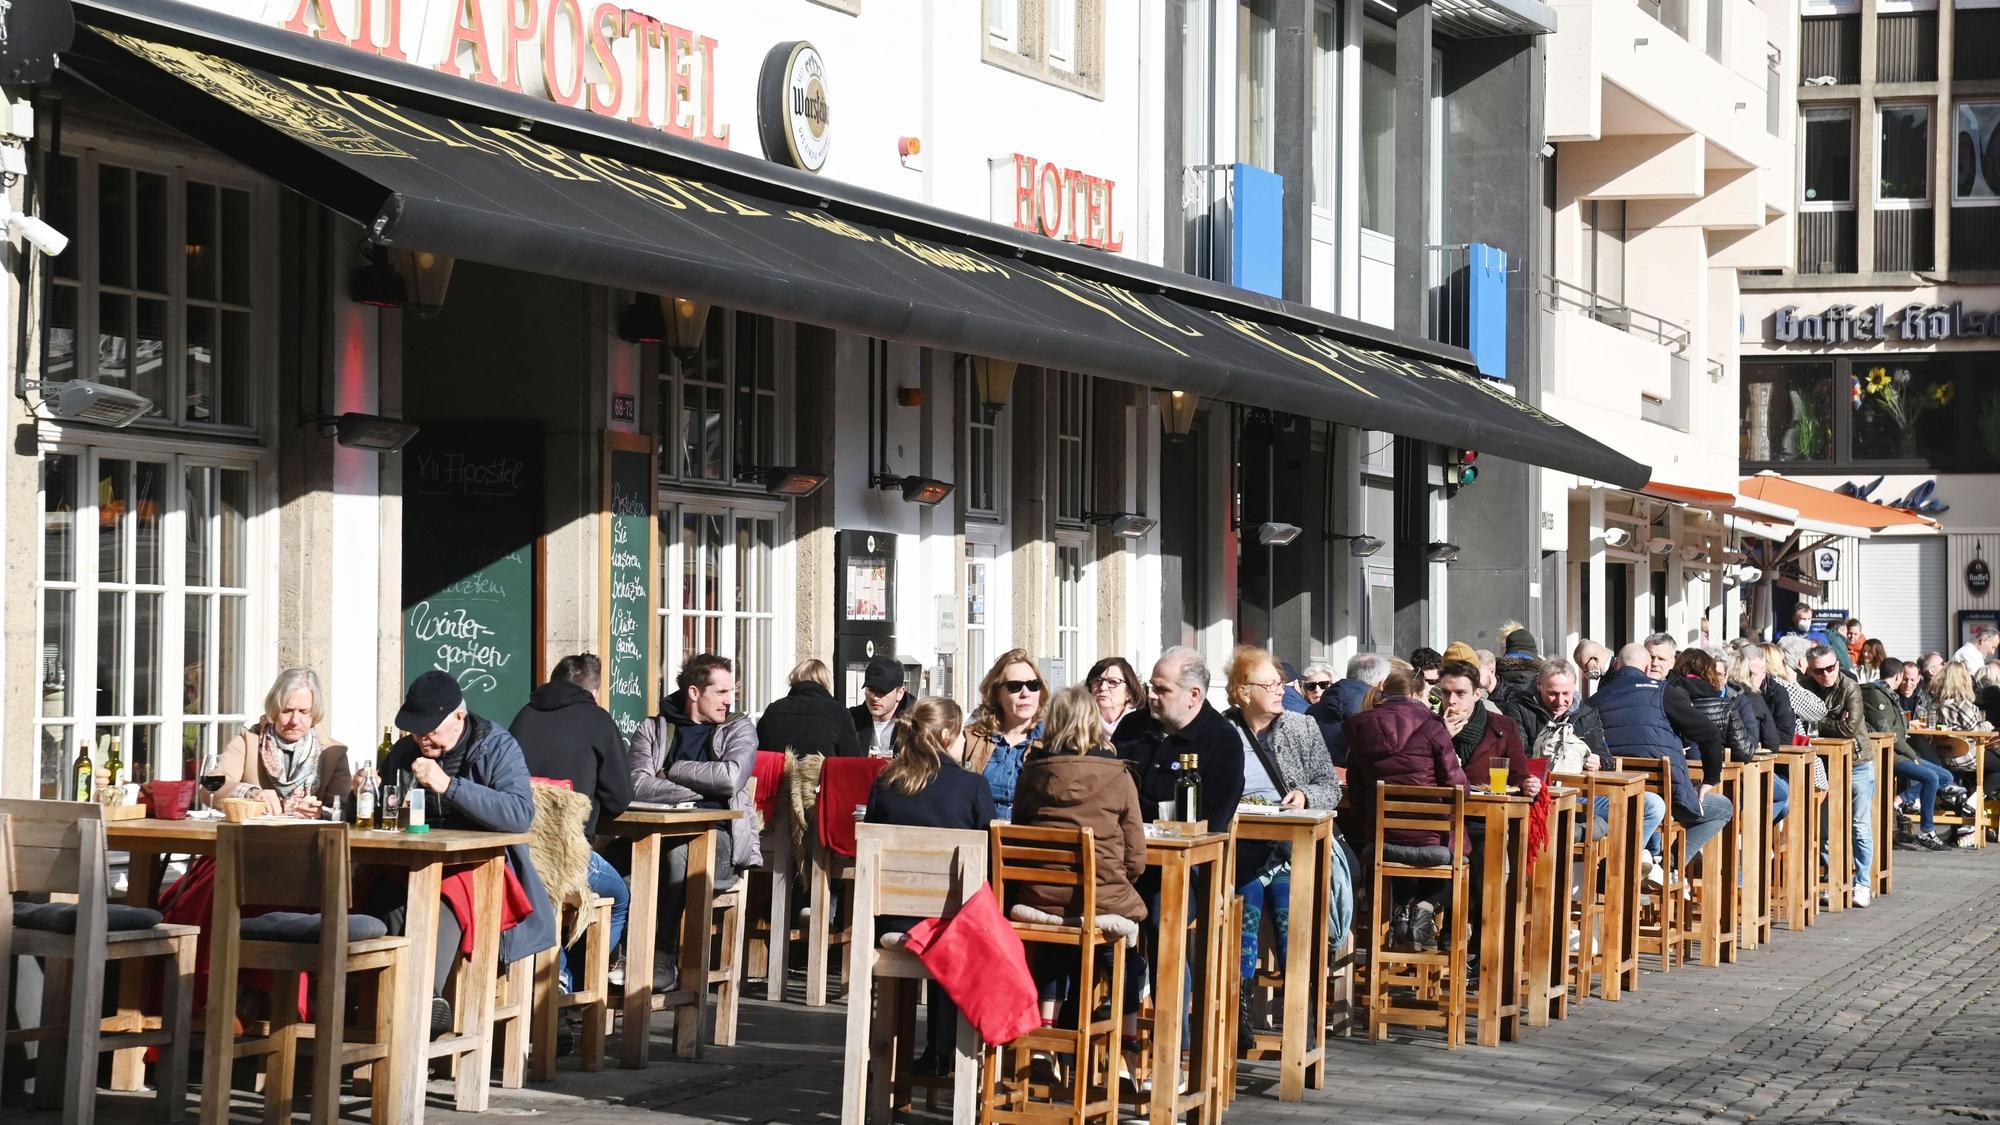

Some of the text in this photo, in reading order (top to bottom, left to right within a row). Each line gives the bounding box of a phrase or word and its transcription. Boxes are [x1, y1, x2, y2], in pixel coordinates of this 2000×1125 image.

[438, 0, 729, 149] APOSTEL
[1013, 153, 1124, 252] HOTEL
[614, 398, 633, 418] 68-72
[614, 517, 628, 545] Sie
[411, 601, 496, 641] Winter-
[433, 640, 511, 672] garten
